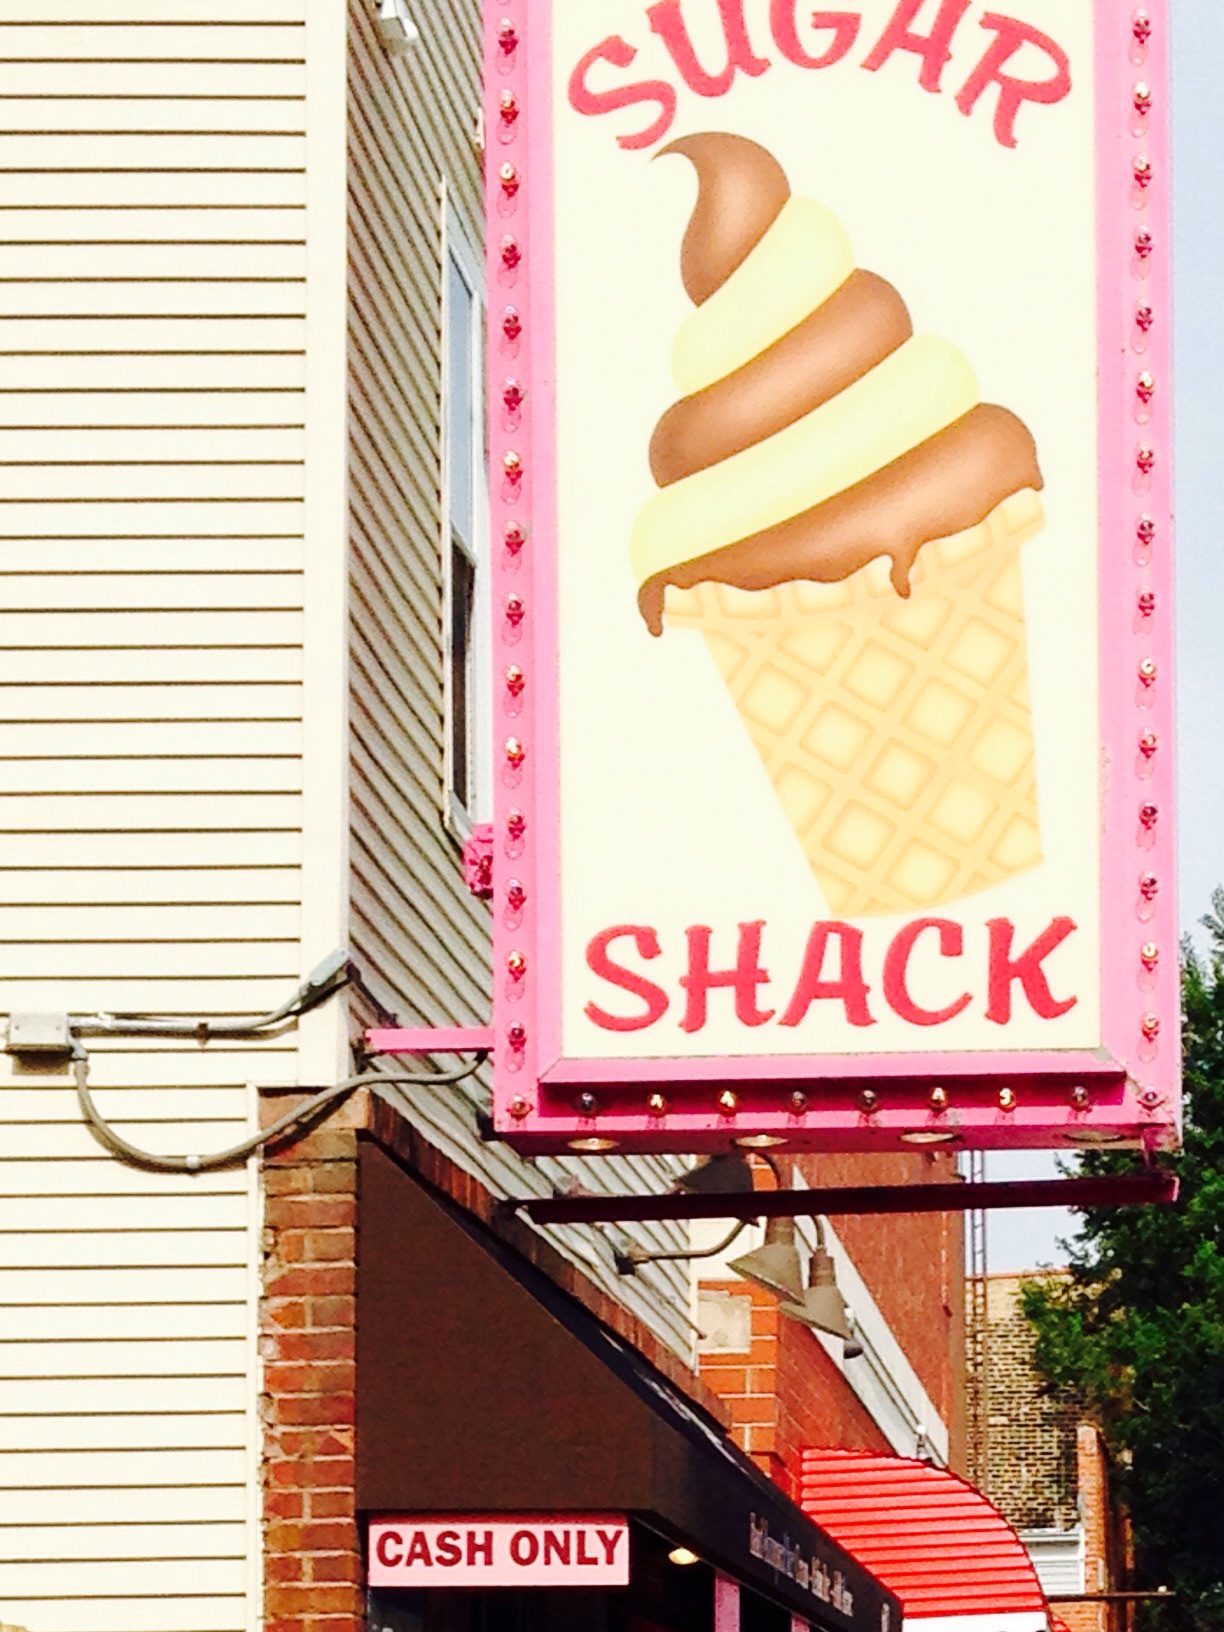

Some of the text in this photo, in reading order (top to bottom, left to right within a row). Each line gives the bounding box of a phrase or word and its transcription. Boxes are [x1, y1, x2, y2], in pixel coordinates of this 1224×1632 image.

[568, 0, 1072, 150] SUGAR
[584, 916, 1077, 1033] SHACK
[376, 1529, 623, 1568] CASH ONLY
